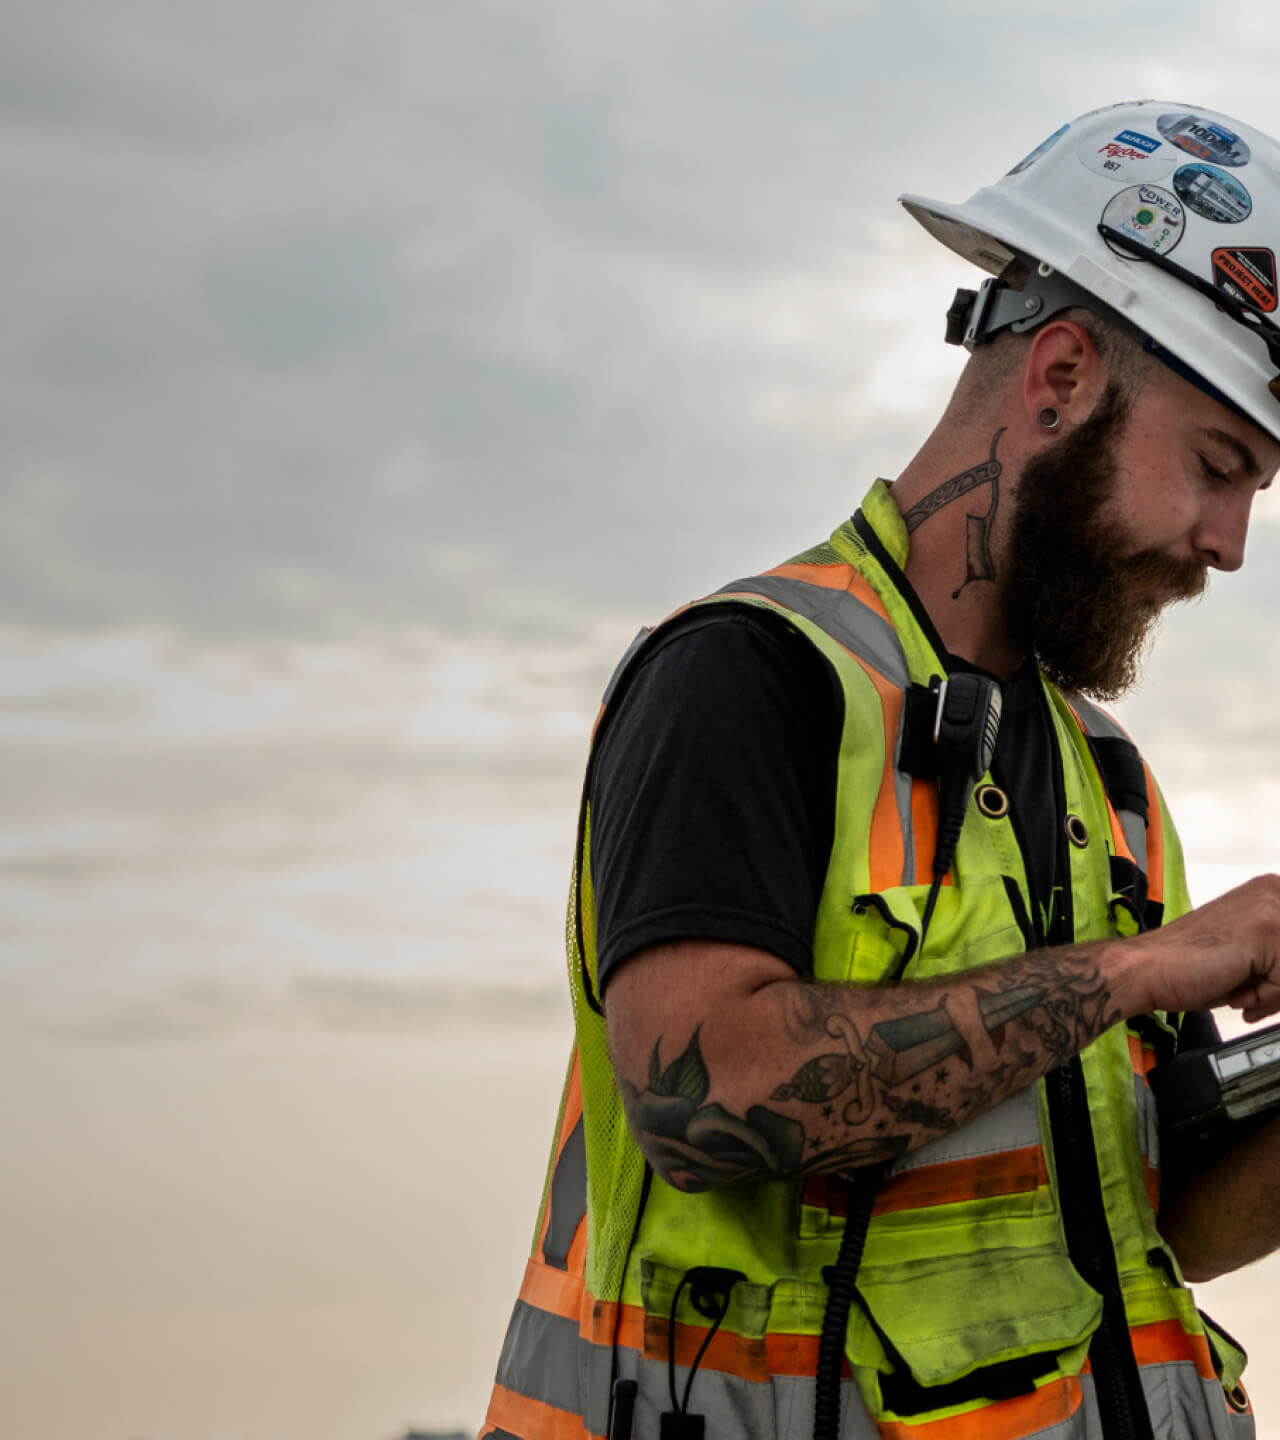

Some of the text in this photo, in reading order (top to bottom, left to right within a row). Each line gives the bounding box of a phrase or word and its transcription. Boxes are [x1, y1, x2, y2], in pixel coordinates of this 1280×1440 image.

[1140, 186, 1181, 217] POWER
[1218, 254, 1253, 286] PROJECT
[1251, 285, 1271, 305] HEAT
